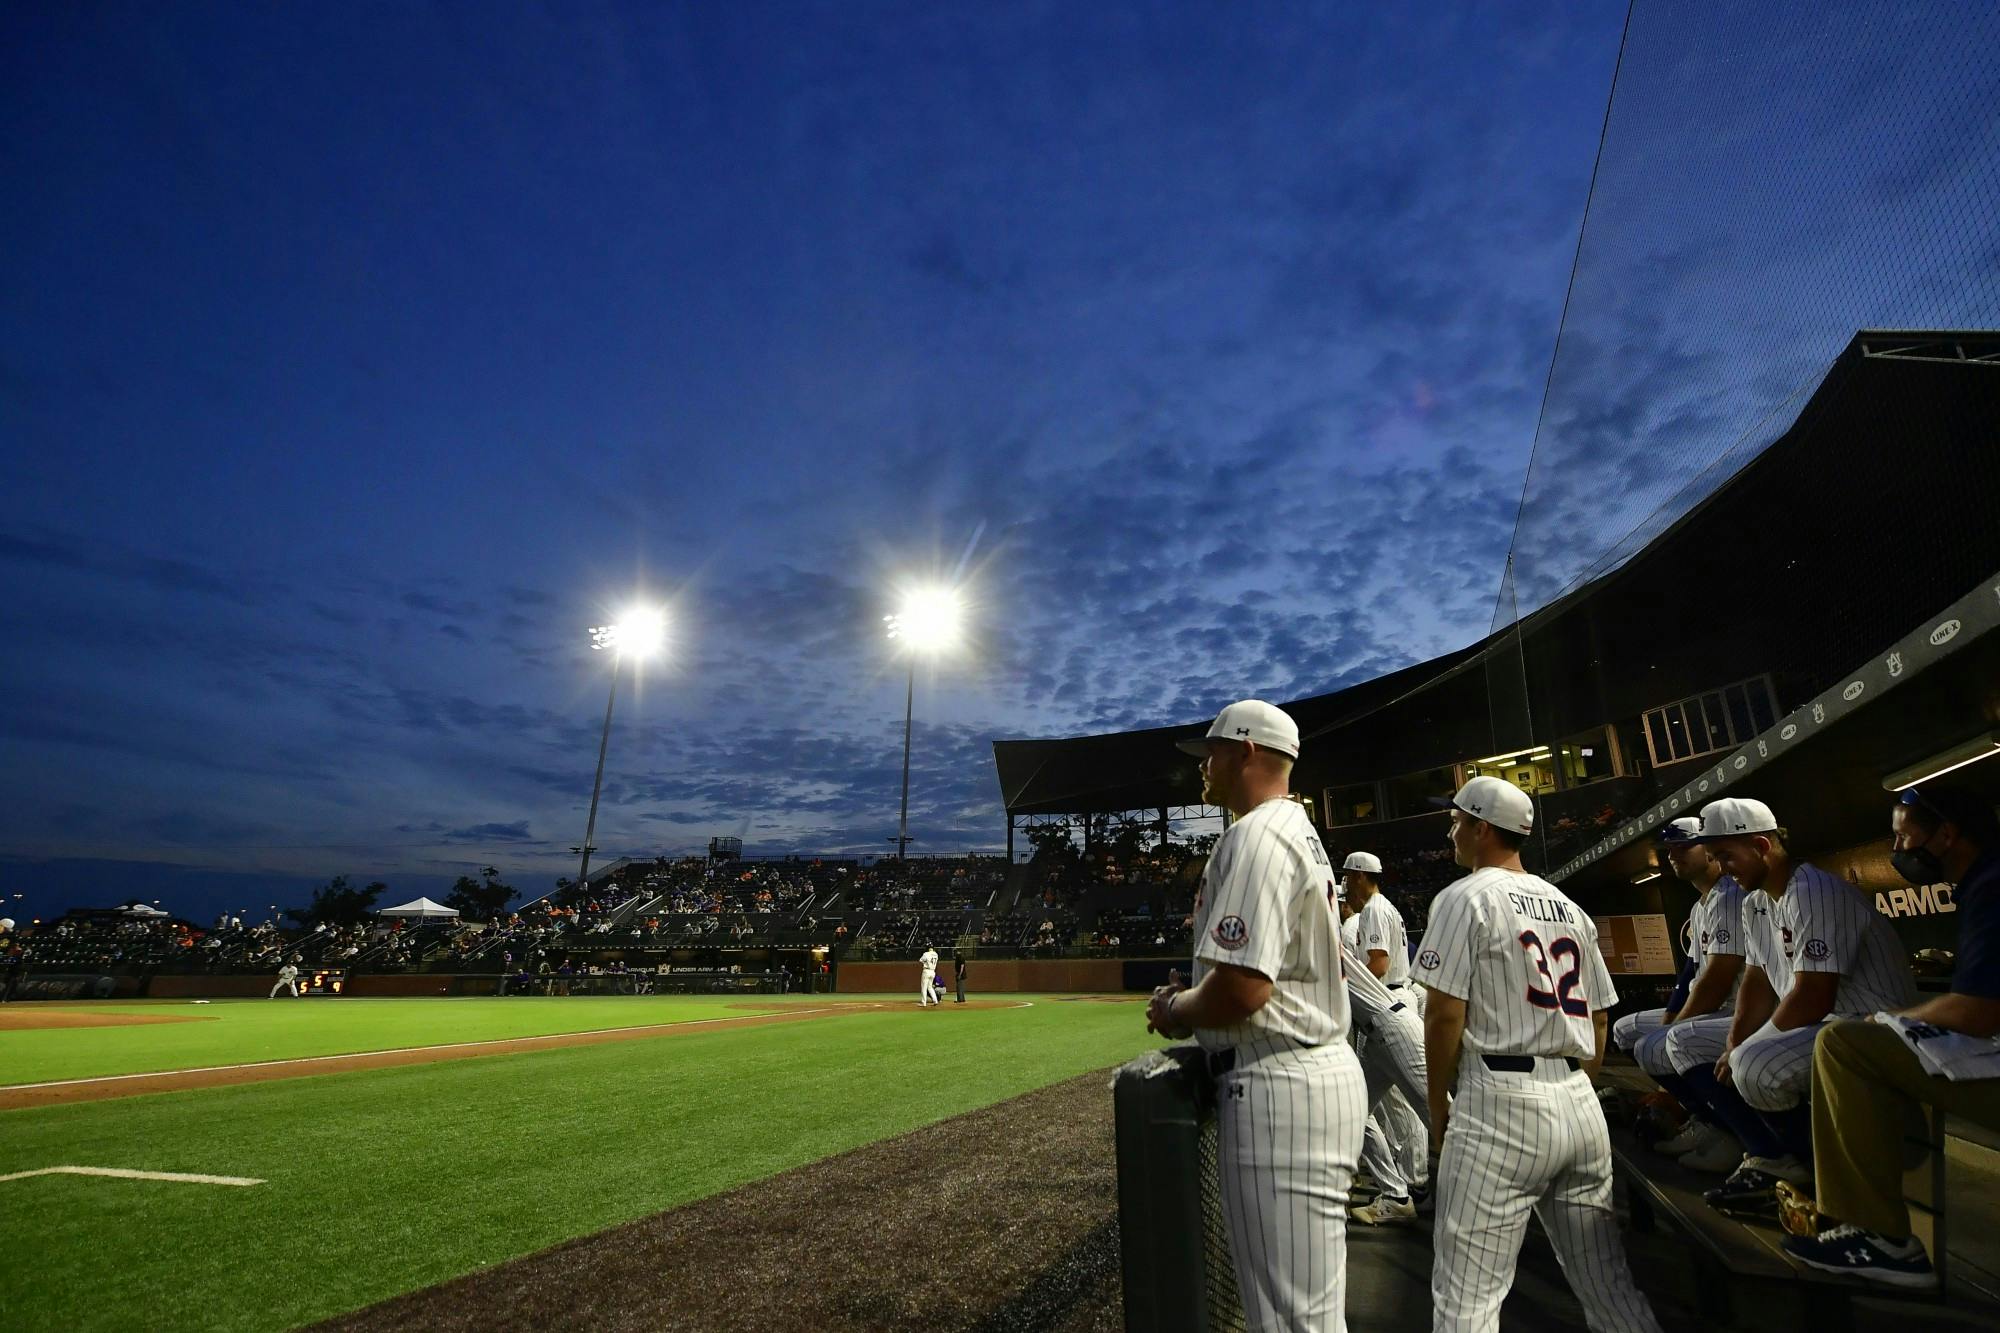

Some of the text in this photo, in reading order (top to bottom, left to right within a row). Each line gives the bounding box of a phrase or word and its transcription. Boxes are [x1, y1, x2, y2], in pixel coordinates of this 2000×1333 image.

[1931, 622, 1959, 643] LINE-X
[1508, 892, 1575, 925] SWILLING
[315, 975, 322, 987] 5
[1519, 930, 1589, 1018] 32
[300, 982, 308, 993] 5
[333, 982, 340, 992] 9
